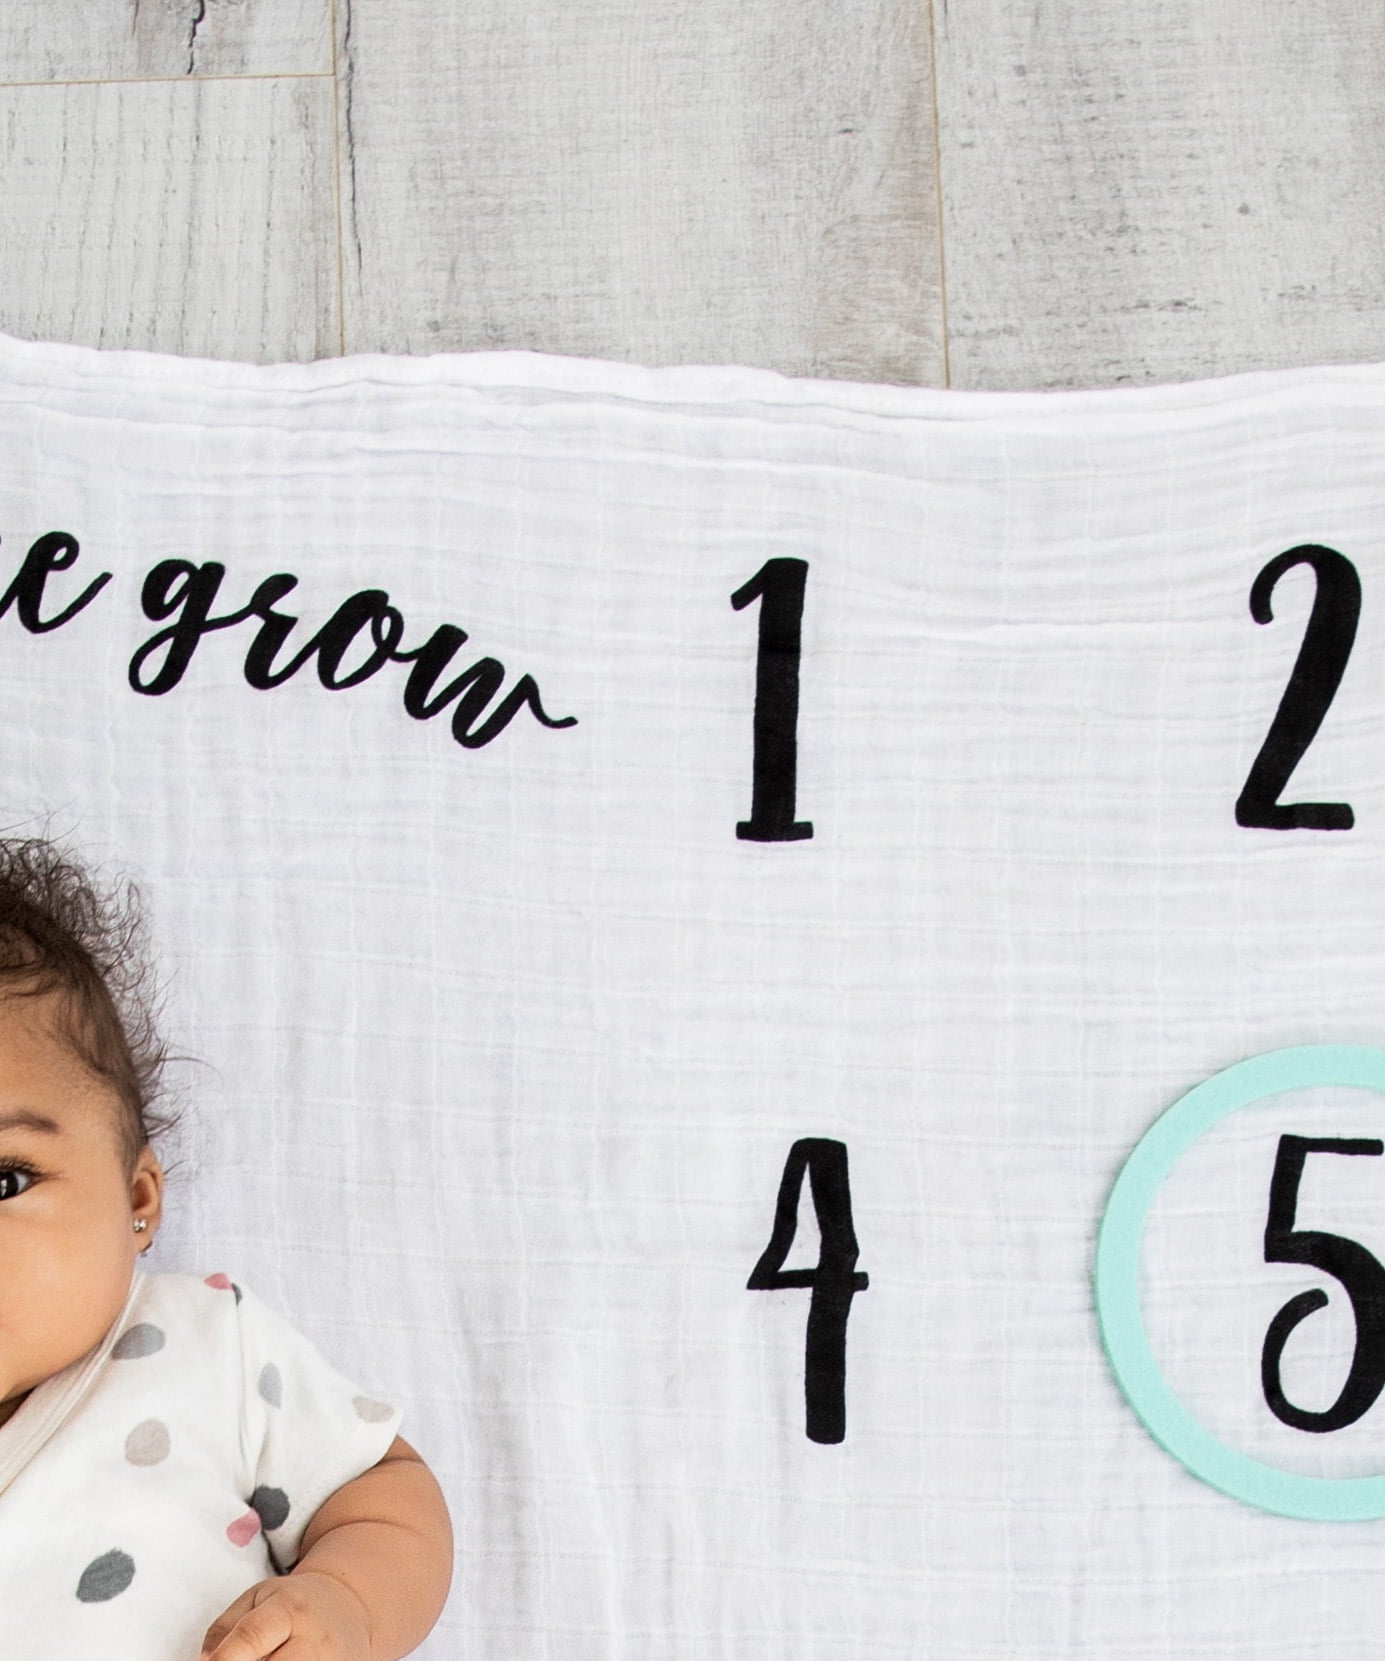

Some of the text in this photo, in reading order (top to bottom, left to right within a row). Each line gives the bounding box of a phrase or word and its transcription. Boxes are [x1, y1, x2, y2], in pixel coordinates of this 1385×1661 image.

[129, 559, 578, 749] grow
[731, 558, 813, 842] 1
[1235, 544, 1361, 830] 2
[747, 1138, 869, 1444] 4
